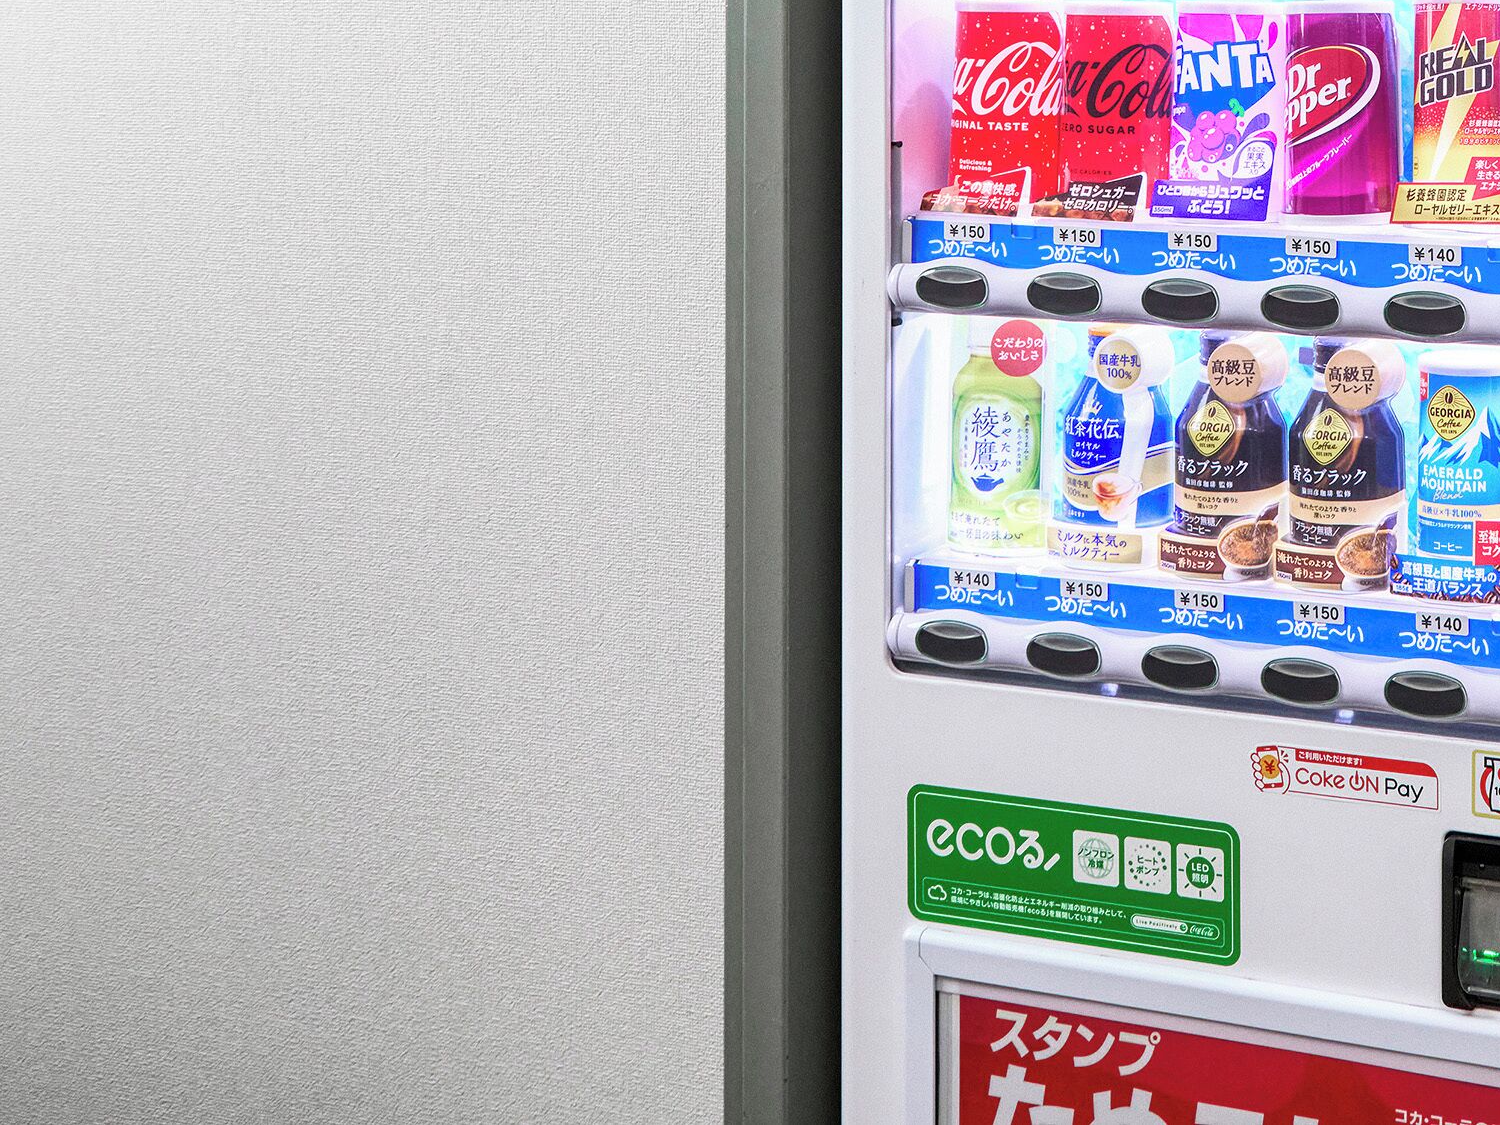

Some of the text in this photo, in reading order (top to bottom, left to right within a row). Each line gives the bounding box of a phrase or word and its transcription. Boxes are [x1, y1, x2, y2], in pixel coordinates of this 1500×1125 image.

[1420, 32, 1493, 80] REAL
[1420, 64, 1493, 107] GOLD
[988, 122, 1029, 131] TASTE
[1088, 125, 1135, 134] SUGAR
[1475, 160, 1498, 169] 楽しく
[1069, 184, 1136, 199] ゼロシュガー
[1415, 204, 1500, 215] ローヤルゼリーエキス
[949, 224, 985, 239] ¥150
[1059, 229, 1096, 243] ¥150
[1173, 234, 1212, 248] ¥150
[1291, 239, 1331, 254] ¥150
[1414, 247, 1455, 261] ¥140
[994, 337, 1044, 349] こだわりの
[998, 350, 1039, 361] おいしさ
[1099, 353, 1141, 367] 国産牛乳
[1107, 367, 1132, 379] 100%
[1212, 358, 1256, 376] 高級豆
[1214, 375, 1254, 387] ブレンド
[1329, 366, 1375, 384] 高級豆
[1331, 382, 1373, 394] ブレンド
[1430, 406, 1472, 419] GEORGIA
[1076, 441, 1100, 450] ロイヤル
[1177, 456, 1249, 476] 香るブラック
[1424, 465, 1483, 480] EMERALD
[1293, 465, 1367, 486] 香るブラック
[1421, 477, 1486, 492] MOUNTAIN
[1187, 523, 1211, 535] コーヒー
[1303, 533, 1328, 544] コーヒー
[1063, 544, 1119, 560] ミルクティー
[1434, 541, 1462, 551] コーヒー
[1177, 557, 1214, 570] 香りとコク
[954, 573, 990, 587] ¥140
[1293, 568, 1332, 580] 香りとコク
[1066, 582, 1102, 596] ¥150
[1180, 593, 1218, 607] ¥150
[1299, 605, 1339, 619] ¥150
[1421, 616, 1462, 631] ¥140
[1295, 769, 1345, 789] Coke
[1384, 777, 1424, 804] Pay
[1078, 848, 1115, 859] ノンフロン
[1137, 856, 1158, 865] ヒート
[1191, 863, 1209, 872] LED
[1192, 874, 1209, 884] 照明
[989, 1009, 1161, 1077] スタンプ
